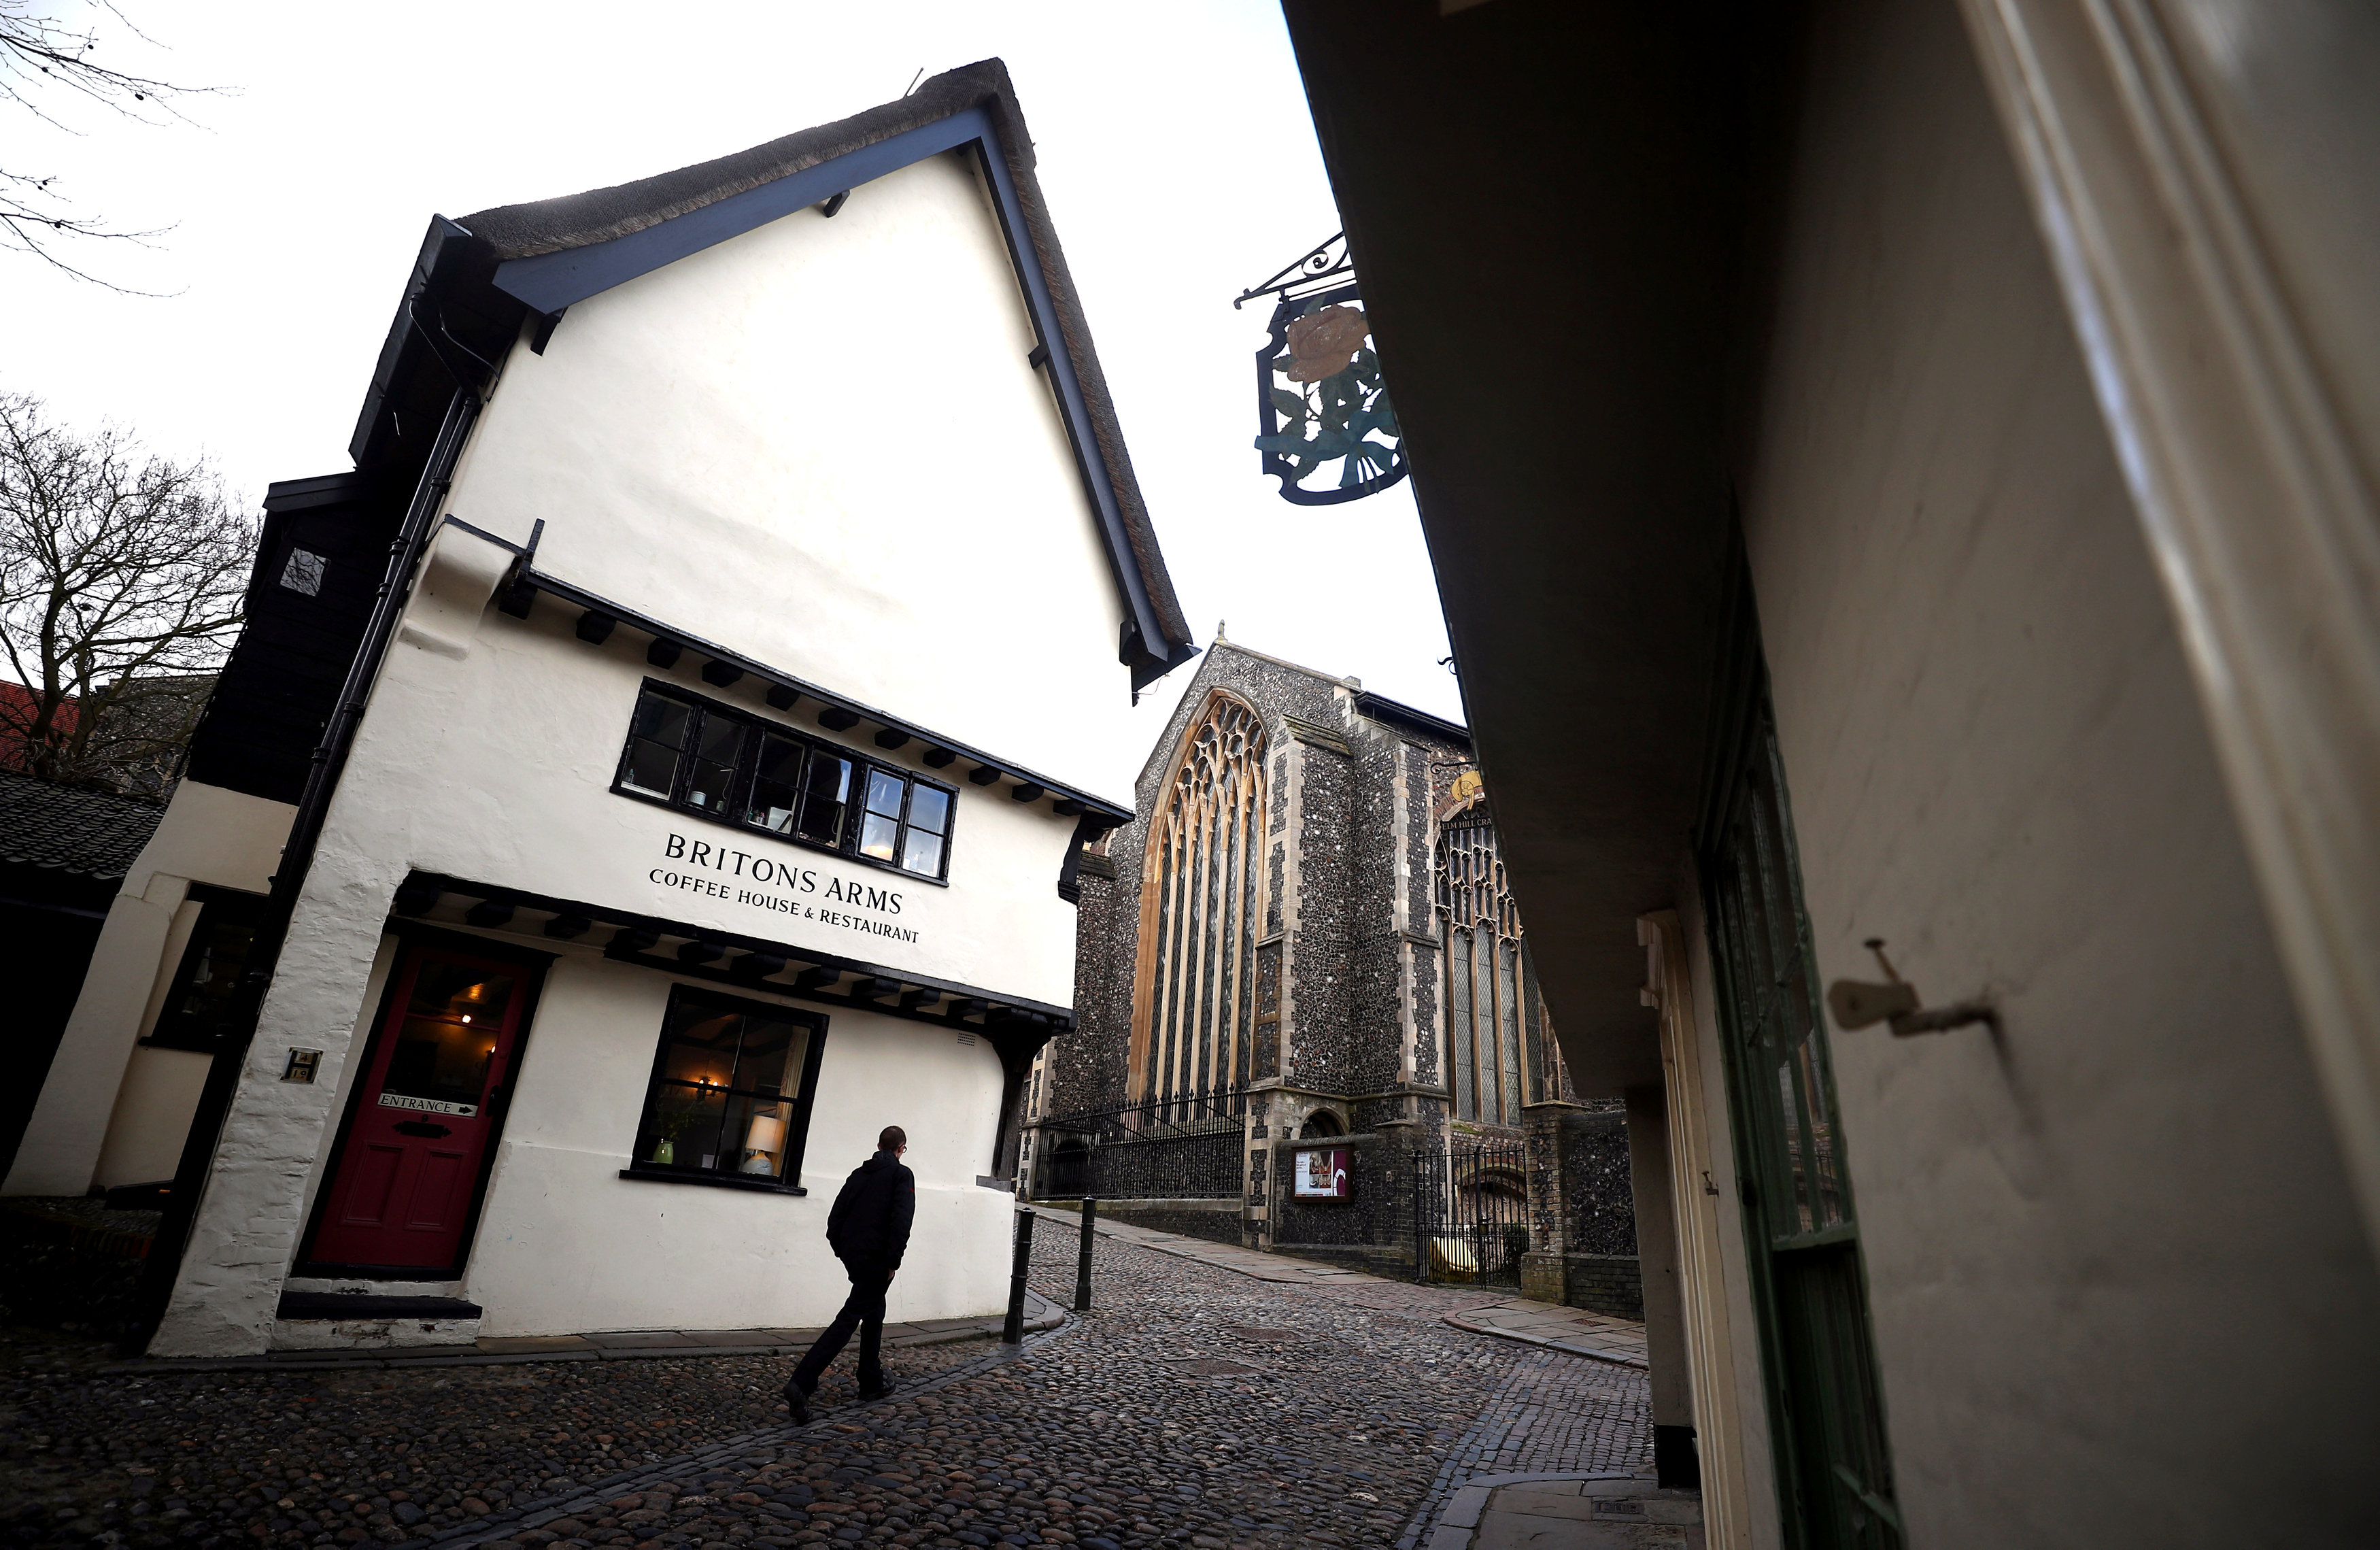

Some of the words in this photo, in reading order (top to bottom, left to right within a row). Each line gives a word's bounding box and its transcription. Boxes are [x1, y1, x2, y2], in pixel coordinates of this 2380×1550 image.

[1442, 822, 1457, 830] ELM
[1459, 820, 1476, 828] HILL
[1477, 818, 1492, 826] CRA
[664, 832, 817, 893] BRITONS
[824, 877, 903, 915] ARMS
[649, 869, 730, 899] COFFEE
[738, 890, 800, 915] HOUSE
[804, 907, 815, 920] &
[819, 909, 919, 944] RESTAURANT
[380, 1095, 452, 1113] ENTRANCE
